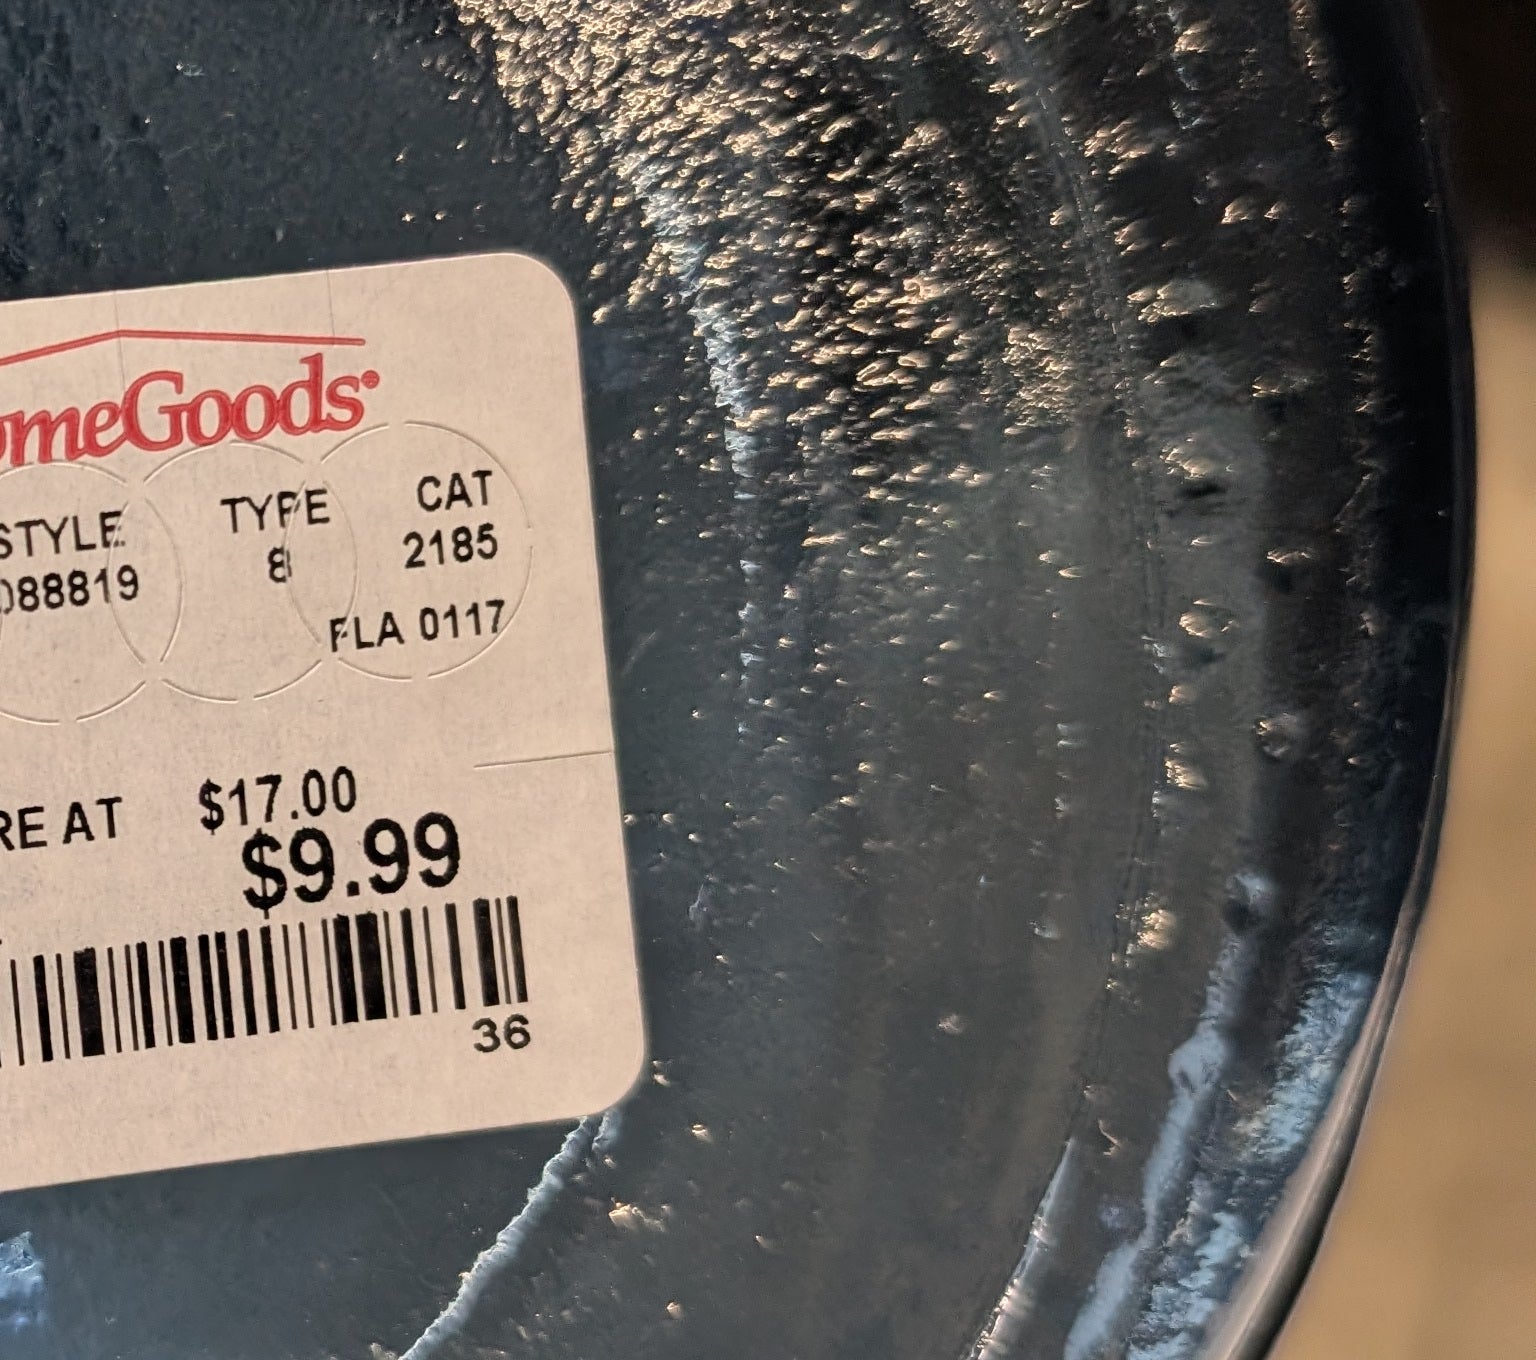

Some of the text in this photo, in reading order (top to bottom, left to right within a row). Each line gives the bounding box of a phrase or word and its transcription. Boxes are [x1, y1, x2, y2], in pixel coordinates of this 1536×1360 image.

[221, 489, 330, 533] TYPE
[417, 470, 493, 512] CAT
[267, 547, 292, 583] 8
[403, 523, 498, 569] 2185
[330, 600, 504, 652] FLA 0117
[62, 796, 122, 845] AT
[199, 766, 356, 835] $17.00
[242, 812, 460, 919] $9.99
[472, 1013, 531, 1053] 36
